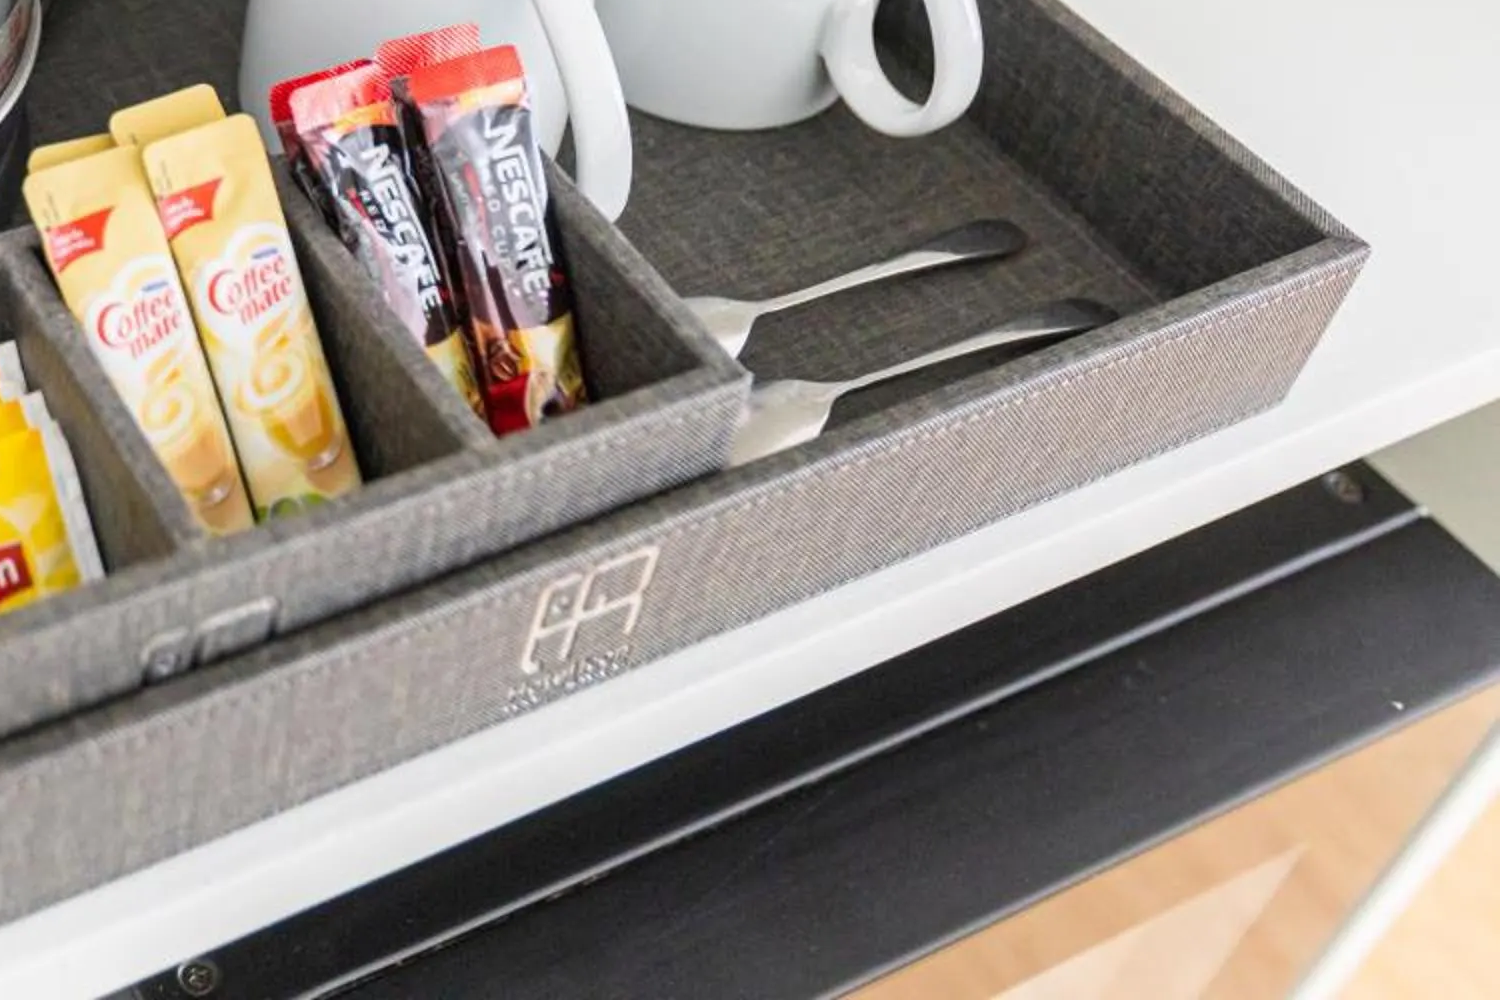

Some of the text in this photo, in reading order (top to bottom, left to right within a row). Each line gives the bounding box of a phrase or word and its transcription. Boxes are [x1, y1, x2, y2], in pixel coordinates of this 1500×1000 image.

[207, 254, 285, 316] Coffee
[240, 276, 291, 325] mate
[97, 288, 175, 350] Coffee
[129, 311, 181, 360] mate
